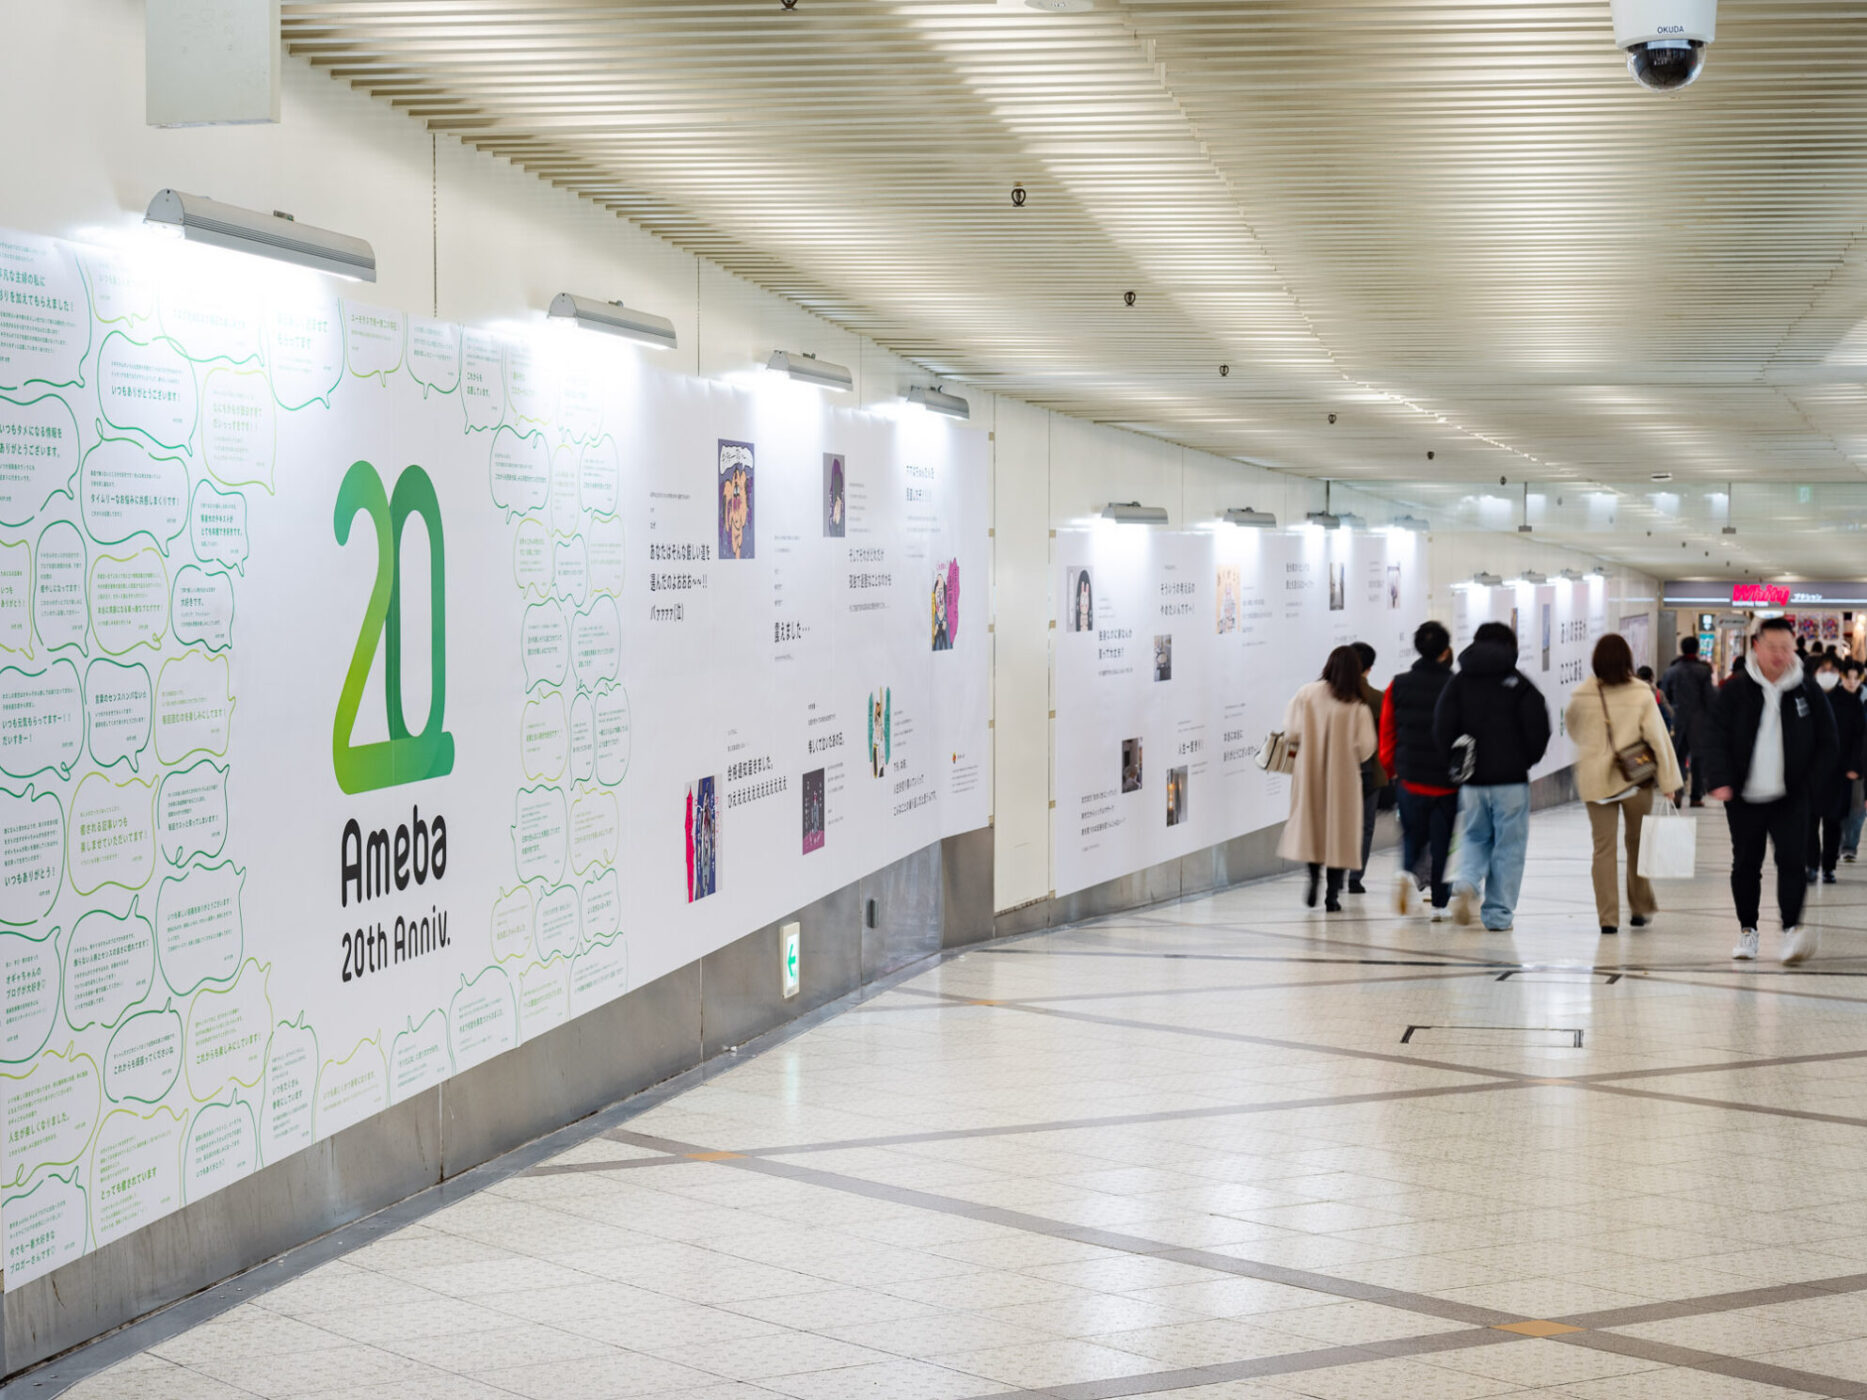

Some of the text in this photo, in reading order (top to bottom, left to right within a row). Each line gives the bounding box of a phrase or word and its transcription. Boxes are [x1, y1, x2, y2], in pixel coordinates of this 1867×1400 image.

[1657, 26, 1684, 34] OKUDA
[333, 460, 455, 795] 20
[1732, 584, 1790, 606] Whity
[342, 804, 446, 908] Ameba
[342, 904, 450, 983] 20th Anniv.
